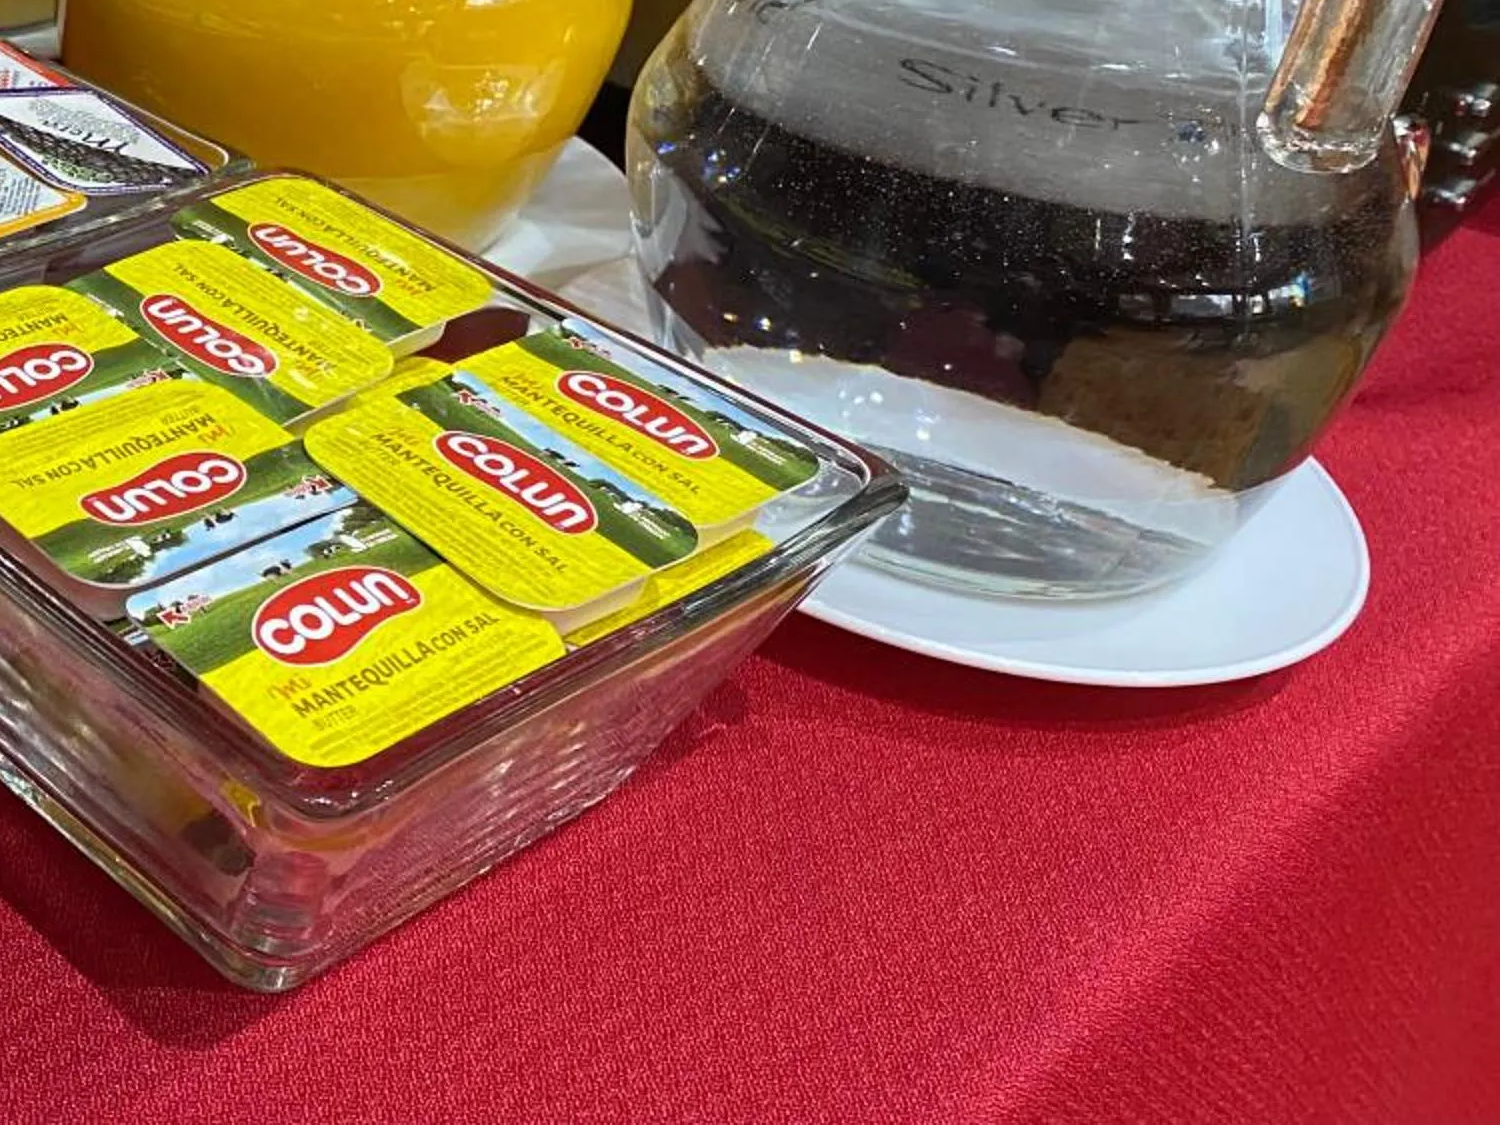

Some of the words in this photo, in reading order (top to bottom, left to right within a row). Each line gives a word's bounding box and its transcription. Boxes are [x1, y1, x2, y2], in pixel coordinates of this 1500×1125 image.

[254, 227, 372, 296] COLUN
[148, 297, 265, 376] COLUN
[81, 412, 217, 477] MANTEQUILLA
[502, 376, 633, 457] MANTEQUILLA
[632, 450, 670, 473] CON
[671, 470, 701, 495] SAL
[567, 374, 710, 456] COLUN
[11, 476, 47, 491] SAL
[45, 466, 84, 486] CON
[94, 459, 240, 522] COLUN
[373, 433, 501, 526] MANTEQUILLA
[500, 522, 536, 548] CON
[535, 546, 570, 573] SAL
[449, 435, 589, 530] COLUN
[259, 573, 411, 656] COLUN
[291, 641, 431, 718] MANTEQUILLA
[431, 626, 468, 653] CON
[467, 611, 501, 636] SAL
